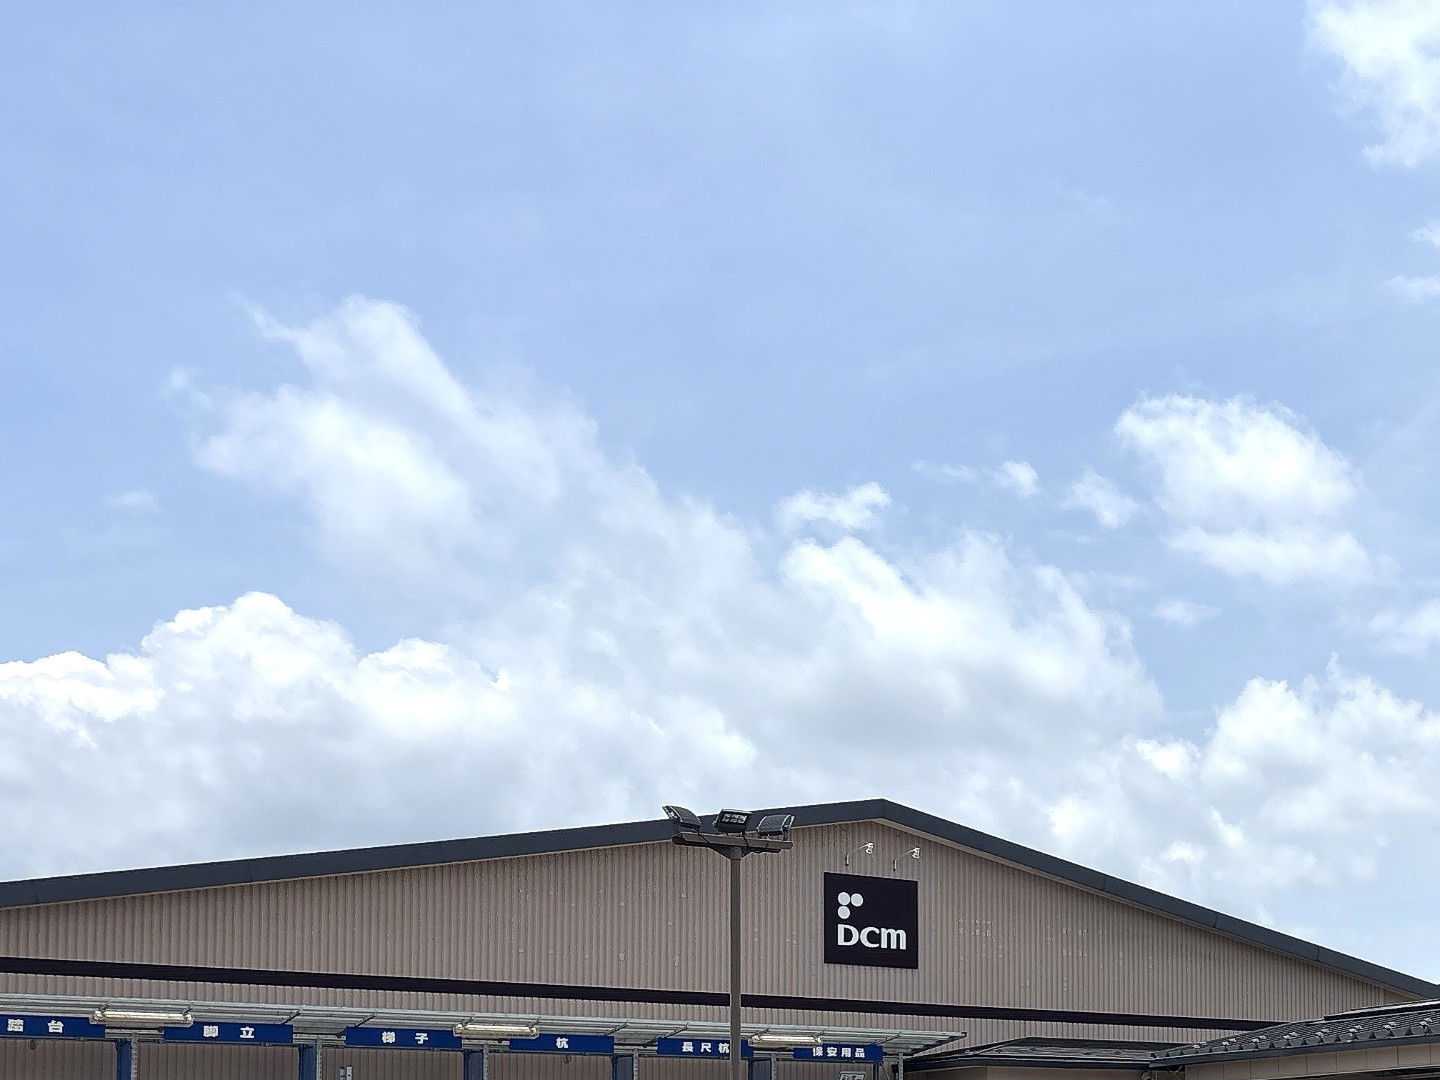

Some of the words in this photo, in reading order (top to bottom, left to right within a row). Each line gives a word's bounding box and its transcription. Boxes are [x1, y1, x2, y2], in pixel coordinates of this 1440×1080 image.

[202, 1025, 255, 1039] 脚立
[381, 1031, 430, 1045] 梯子
[555, 1036, 569, 1049] 杭
[681, 1041, 730, 1054] 長尺杭
[812, 1046, 866, 1059] 保安用品
